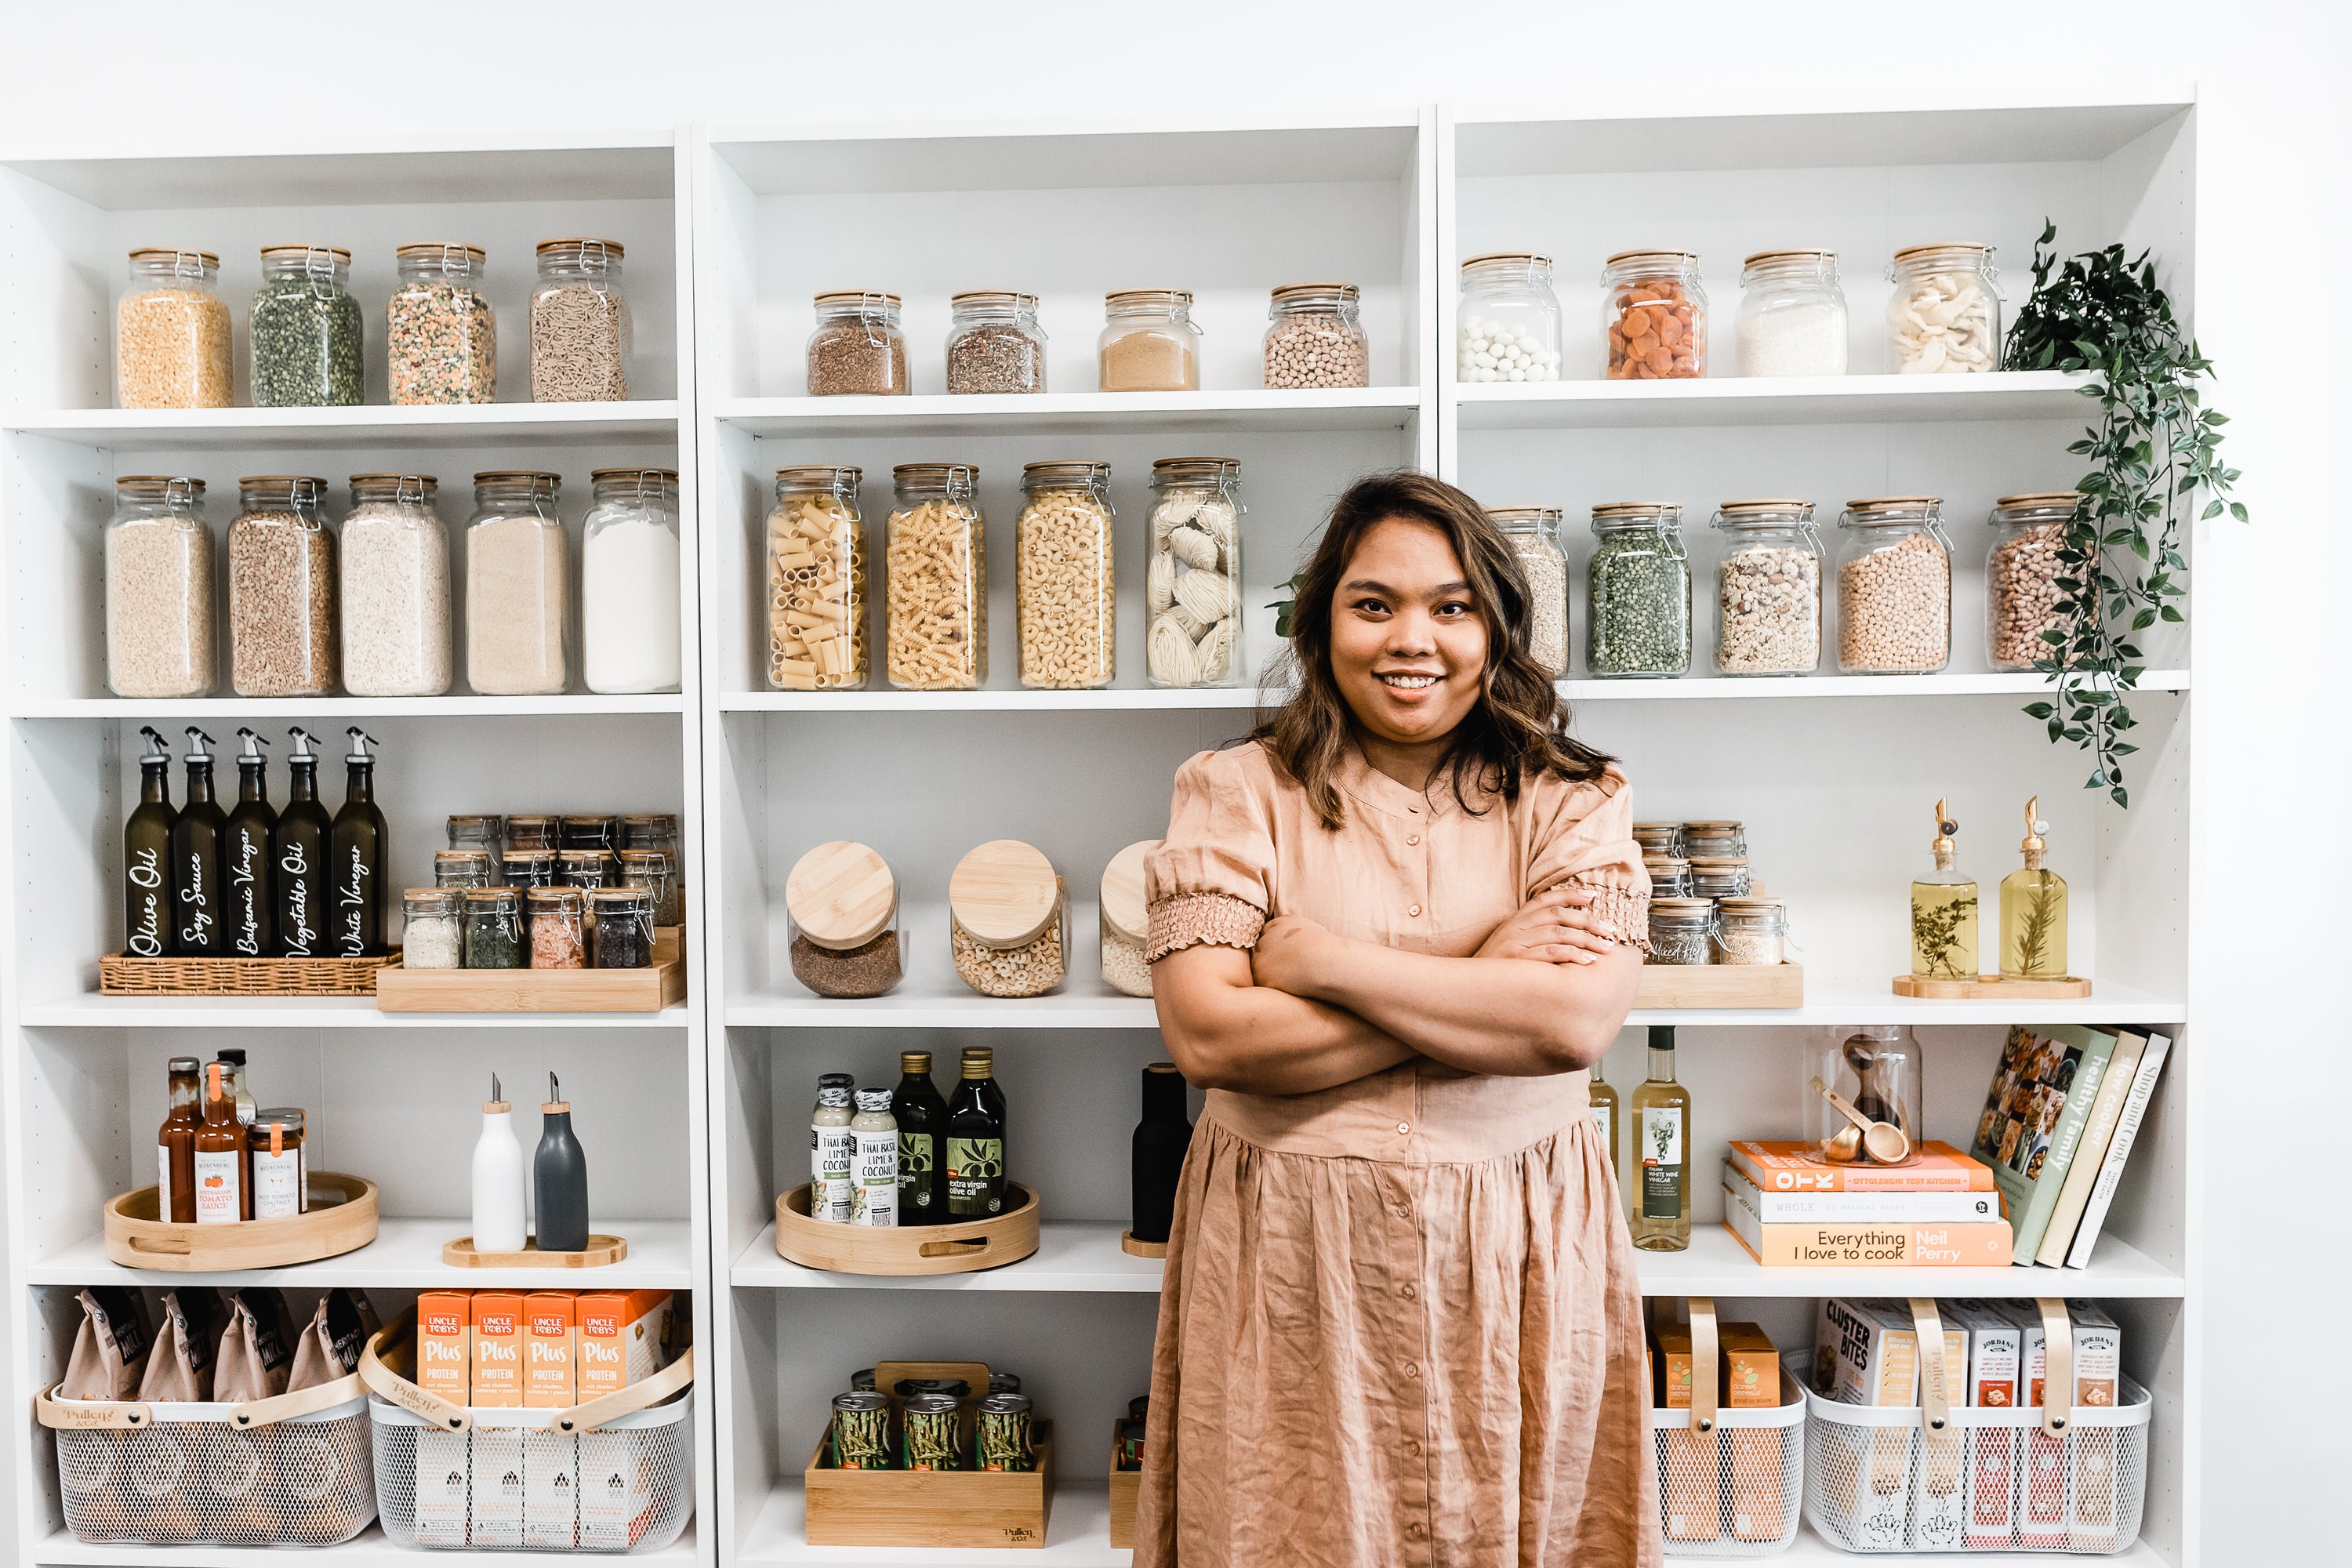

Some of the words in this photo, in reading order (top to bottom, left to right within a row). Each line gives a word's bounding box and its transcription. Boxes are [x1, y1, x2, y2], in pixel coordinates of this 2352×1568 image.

[129, 847, 162, 887] Oil
[232, 827, 259, 886] Vinegar
[281, 841, 307, 874] Oil
[181, 852, 206, 905] Sauce
[340, 845, 369, 906] Vinegar
[129, 893, 162, 956] Olive
[183, 909, 212, 946] Soy
[237, 886, 258, 955] Balsamic
[285, 878, 316, 958] Vegetable
[340, 909, 361, 958] White
[1651, 940, 1682, 961] Mixed
[2111, 1054, 2134, 1091] slow
[2133, 1065, 2158, 1100] Shop
[2067, 1055, 2107, 1116] healthy
[2090, 1094, 2117, 1148] cooker
[2125, 1101, 2141, 1128] and
[823, 1138, 840, 1147] THAI
[862, 1143, 879, 1153] THAI
[2049, 1119, 2084, 1172] family
[2111, 1130, 2133, 1163] Cook
[829, 1149, 848, 1159] LIME
[868, 1155, 887, 1164] LIME
[888, 1154, 893, 1163] &
[823, 1160, 851, 1170] COCON
[862, 1163, 896, 1177] COCONUT
[898, 1174, 916, 1182] virgin
[967, 1181, 987, 1189] virgin
[1776, 1172, 1834, 1189] OTK
[1818, 1231, 1905, 1248] Everything
[1916, 1230, 1947, 1245] Neil
[1795, 1247, 1798, 1259] I
[1804, 1247, 1838, 1259] love
[1843, 1247, 1860, 1259] to
[1864, 1247, 1904, 1259] cook
[1916, 1247, 1962, 1263] Perry
[1827, 1299, 1870, 1349] CLUSTER
[335, 1329, 361, 1350] HERITAG
[1983, 1339, 2013, 1349] JORDANS
[2080, 1337, 2114, 1347] JORDANS
[424, 1341, 462, 1362] Plus
[478, 1341, 517, 1362] Plus
[529, 1341, 567, 1363] Plus
[583, 1341, 619, 1363] Plus
[1841, 1334, 1867, 1370] BITES
[426, 1369, 459, 1379] PROTEIN
[481, 1369, 514, 1380] PROTEIN
[532, 1370, 564, 1380] PROTEIN
[586, 1370, 617, 1381] PROTEIN
